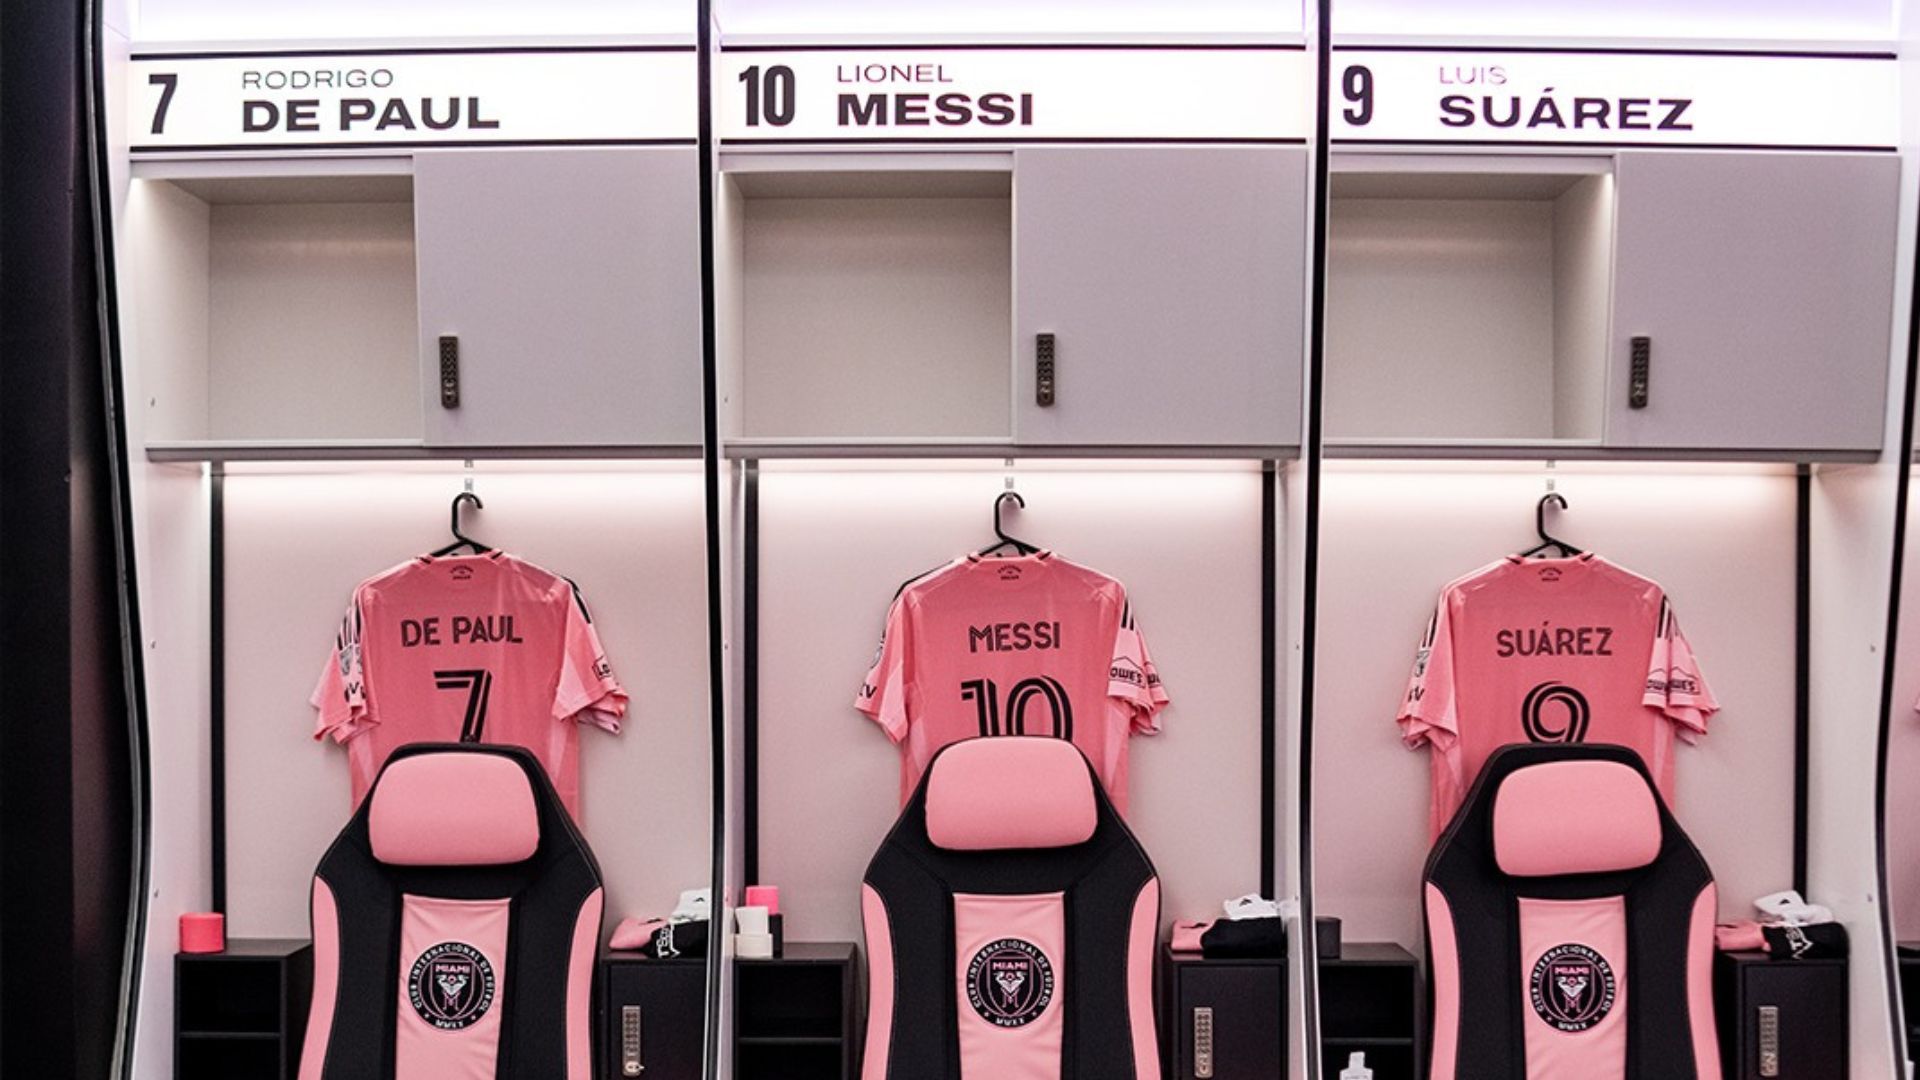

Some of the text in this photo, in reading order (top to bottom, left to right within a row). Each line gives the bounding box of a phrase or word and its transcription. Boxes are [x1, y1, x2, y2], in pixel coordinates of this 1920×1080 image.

[242, 69, 393, 90] RODRIGO
[837, 64, 953, 83] LIONEL
[1439, 66, 1508, 85] LUIS
[149, 73, 178, 135] 7
[739, 65, 796, 127] 10
[837, 93, 1033, 126] MESSI
[1342, 65, 1374, 126] 9
[1439, 88, 1693, 131] SUÁREZ
[242, 97, 500, 132] DE PAUL
[401, 615, 523, 647] DE PAUL
[969, 621, 1060, 652] MESSI
[1497, 621, 1613, 658] SUÁREZ
[433, 669, 492, 743] 7
[960, 675, 1073, 741] 10
[1521, 681, 1591, 744] 9
[992, 961, 1028, 971] MIAMI
